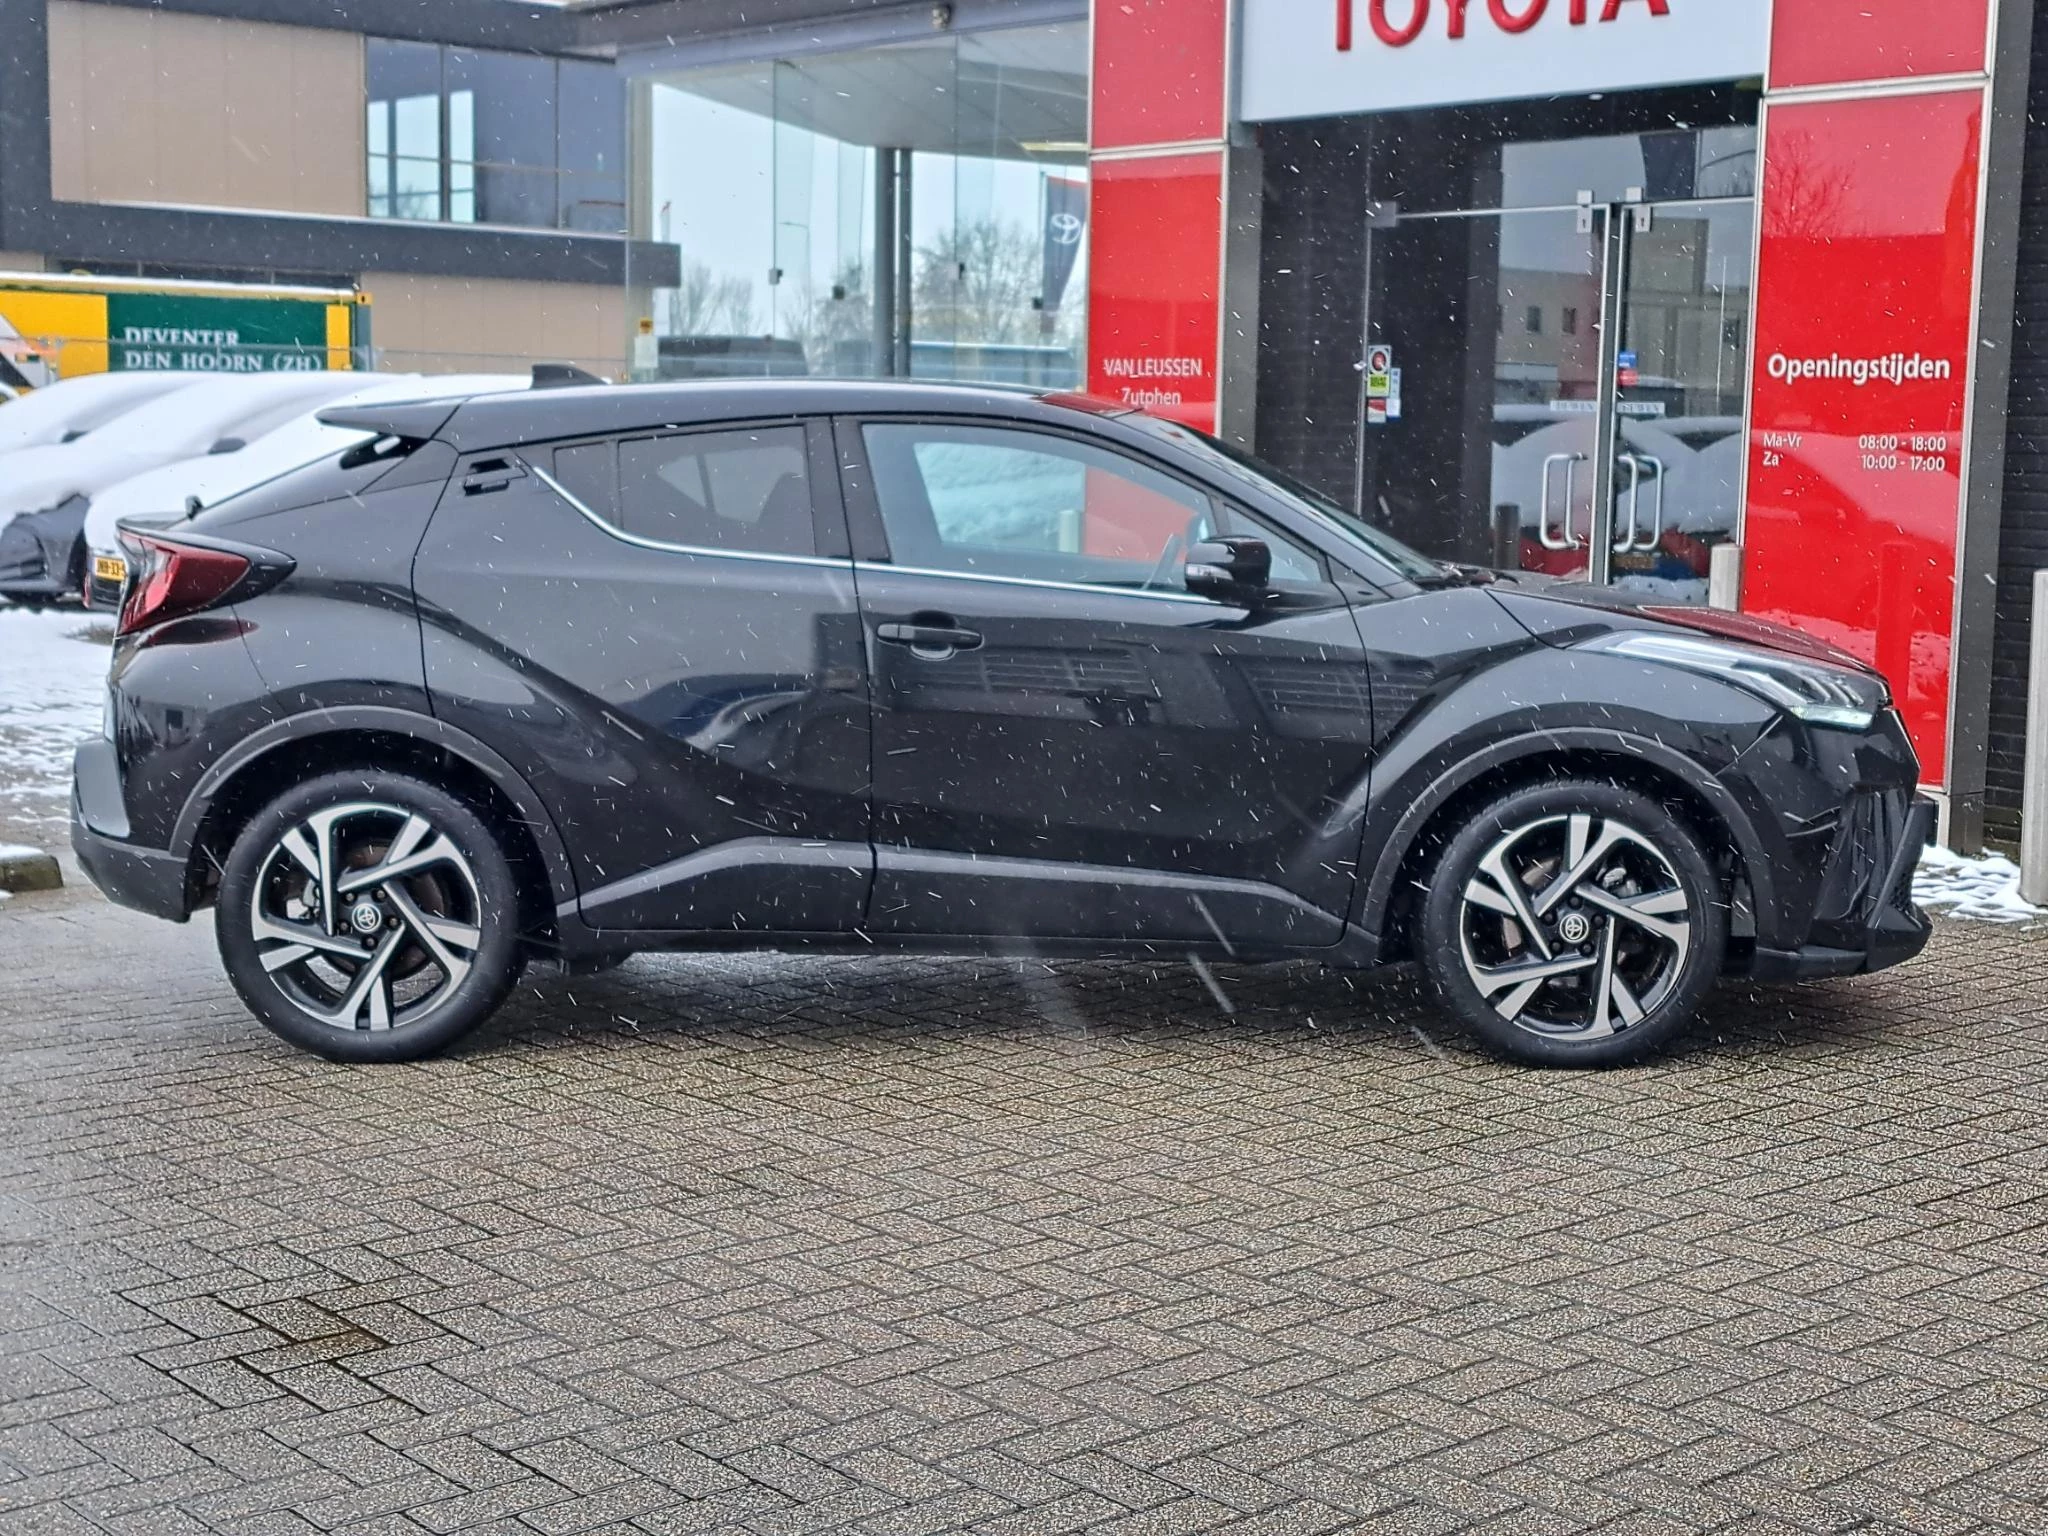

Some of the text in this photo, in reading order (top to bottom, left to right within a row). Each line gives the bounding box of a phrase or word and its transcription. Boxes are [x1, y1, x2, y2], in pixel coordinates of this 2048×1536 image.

[1335, 0, 1671, 52] TOY
[124, 326, 240, 347] DEVENTER
[124, 350, 322, 372] DEN HOORN (ZH)
[1103, 358, 1203, 377] VAN LEUSSEN
[1767, 352, 1951, 386] Openingstijden
[1121, 386, 1182, 409] Zutphen
[1762, 432, 1802, 449] Ma-Vr
[1858, 434, 1898, 451] 08:00
[1911, 435, 1947, 452] 18:00
[1762, 451, 1780, 467] Za
[1861, 454, 1897, 470] 10:00
[1910, 455, 1946, 472] 17:00
